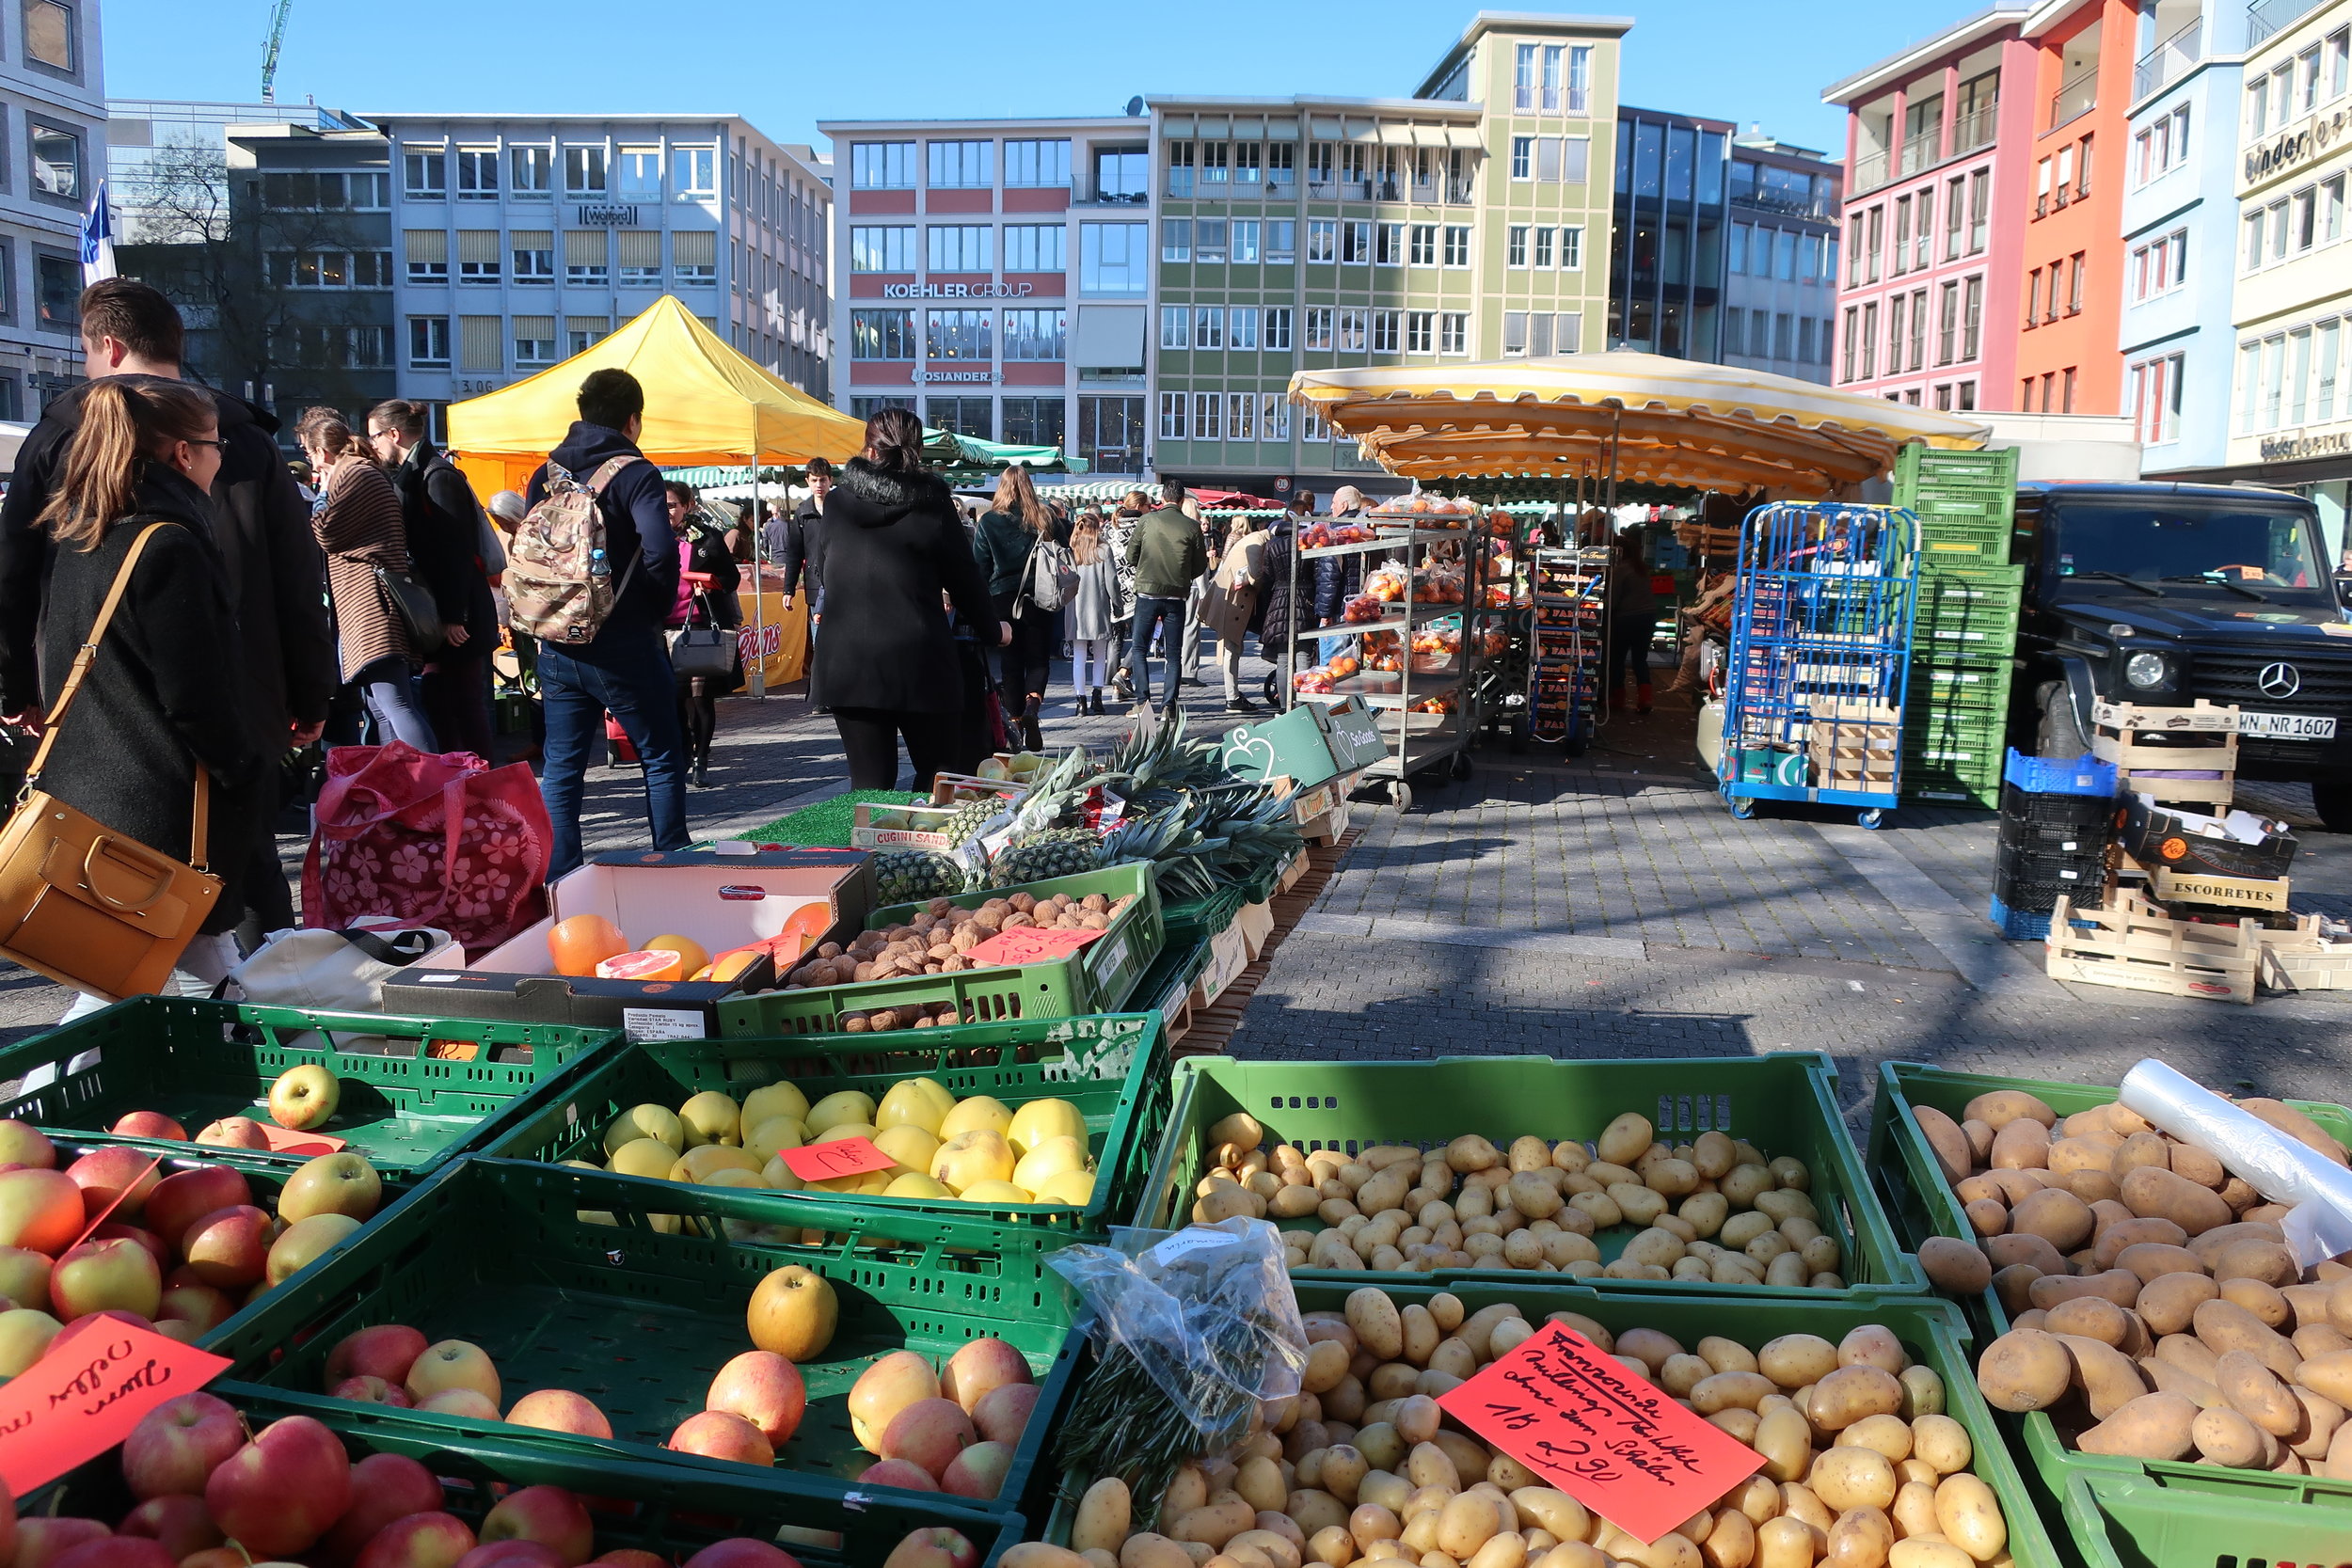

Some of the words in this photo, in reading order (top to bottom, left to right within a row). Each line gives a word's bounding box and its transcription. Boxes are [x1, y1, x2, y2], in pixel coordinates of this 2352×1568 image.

[589, 209, 628, 222] Wolford
[883, 282, 1033, 298] KOEHLER.GROUP
[2269, 717, 2290, 733] NR
[2294, 718, 2333, 736] 1607
[877, 832, 912, 844] CUGINI
[2174, 882, 2274, 902] ESCORREYES
